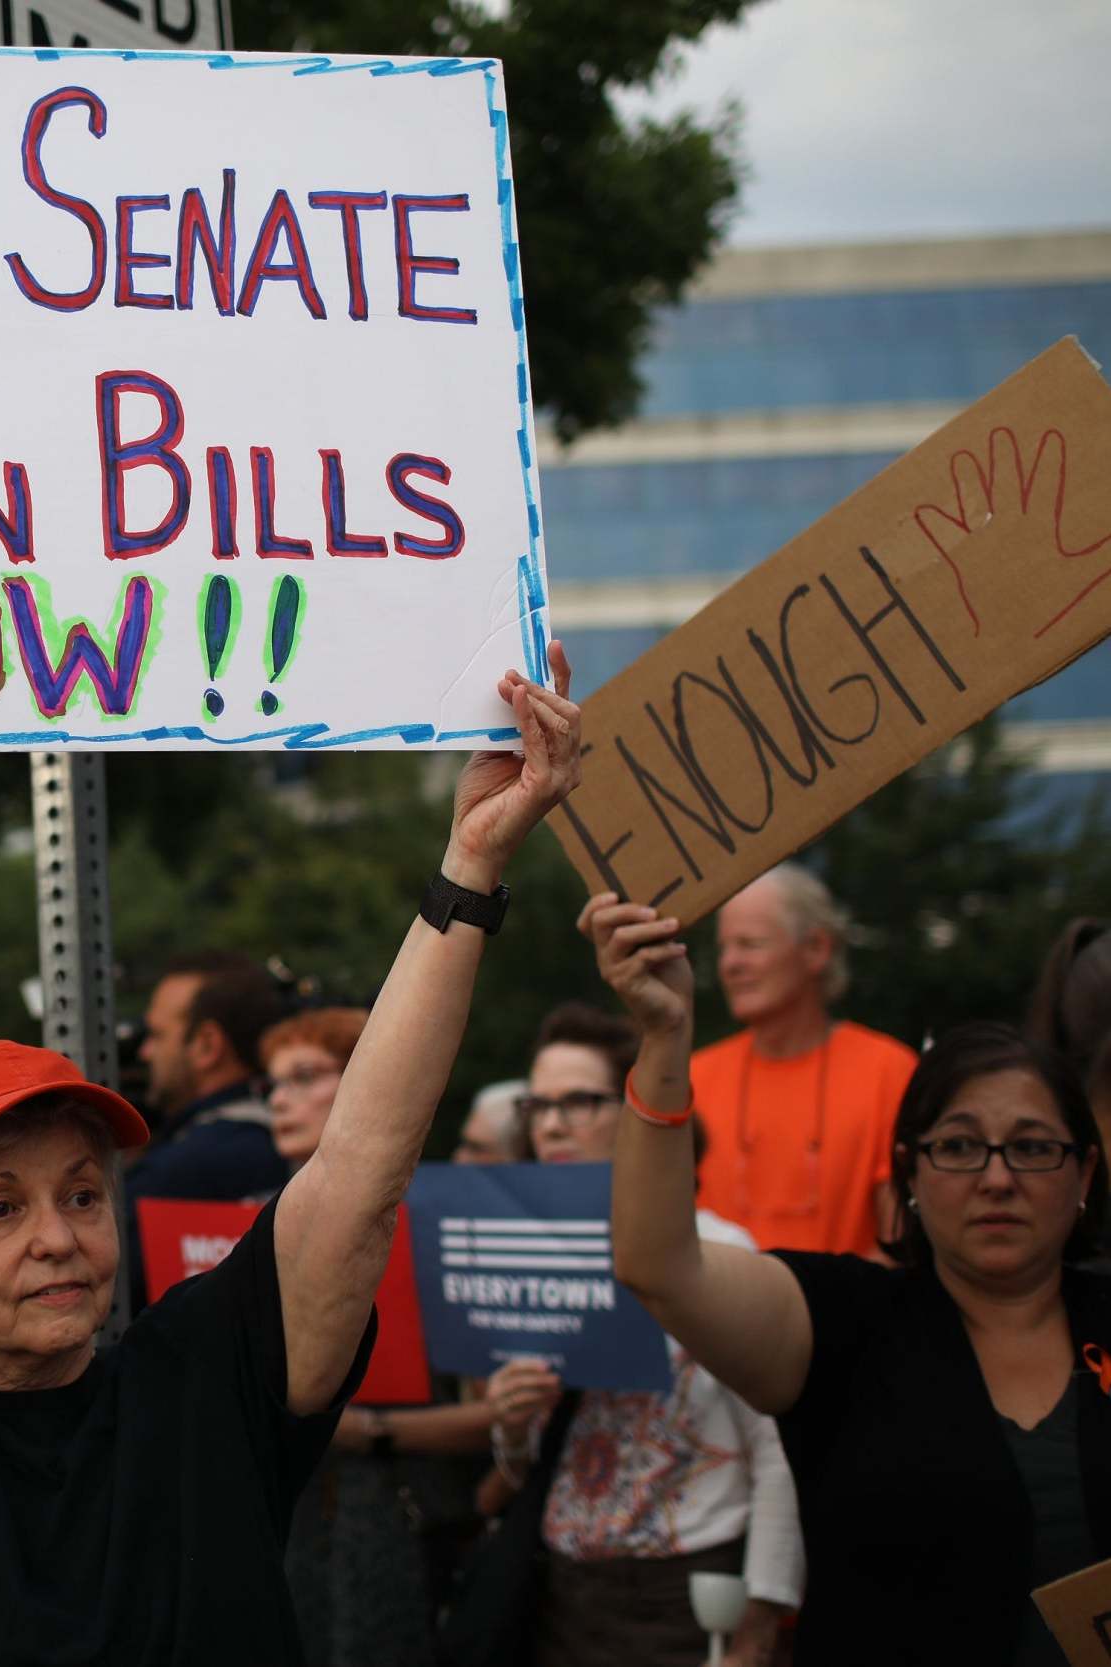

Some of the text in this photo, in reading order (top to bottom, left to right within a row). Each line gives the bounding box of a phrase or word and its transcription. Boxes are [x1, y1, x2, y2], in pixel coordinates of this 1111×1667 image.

[4, 86, 477, 324] SENATE
[95, 370, 465, 561] BILLS
[562, 546, 966, 909] ENOUGH
[442, 1273, 615, 1310] EVERYTOWN
